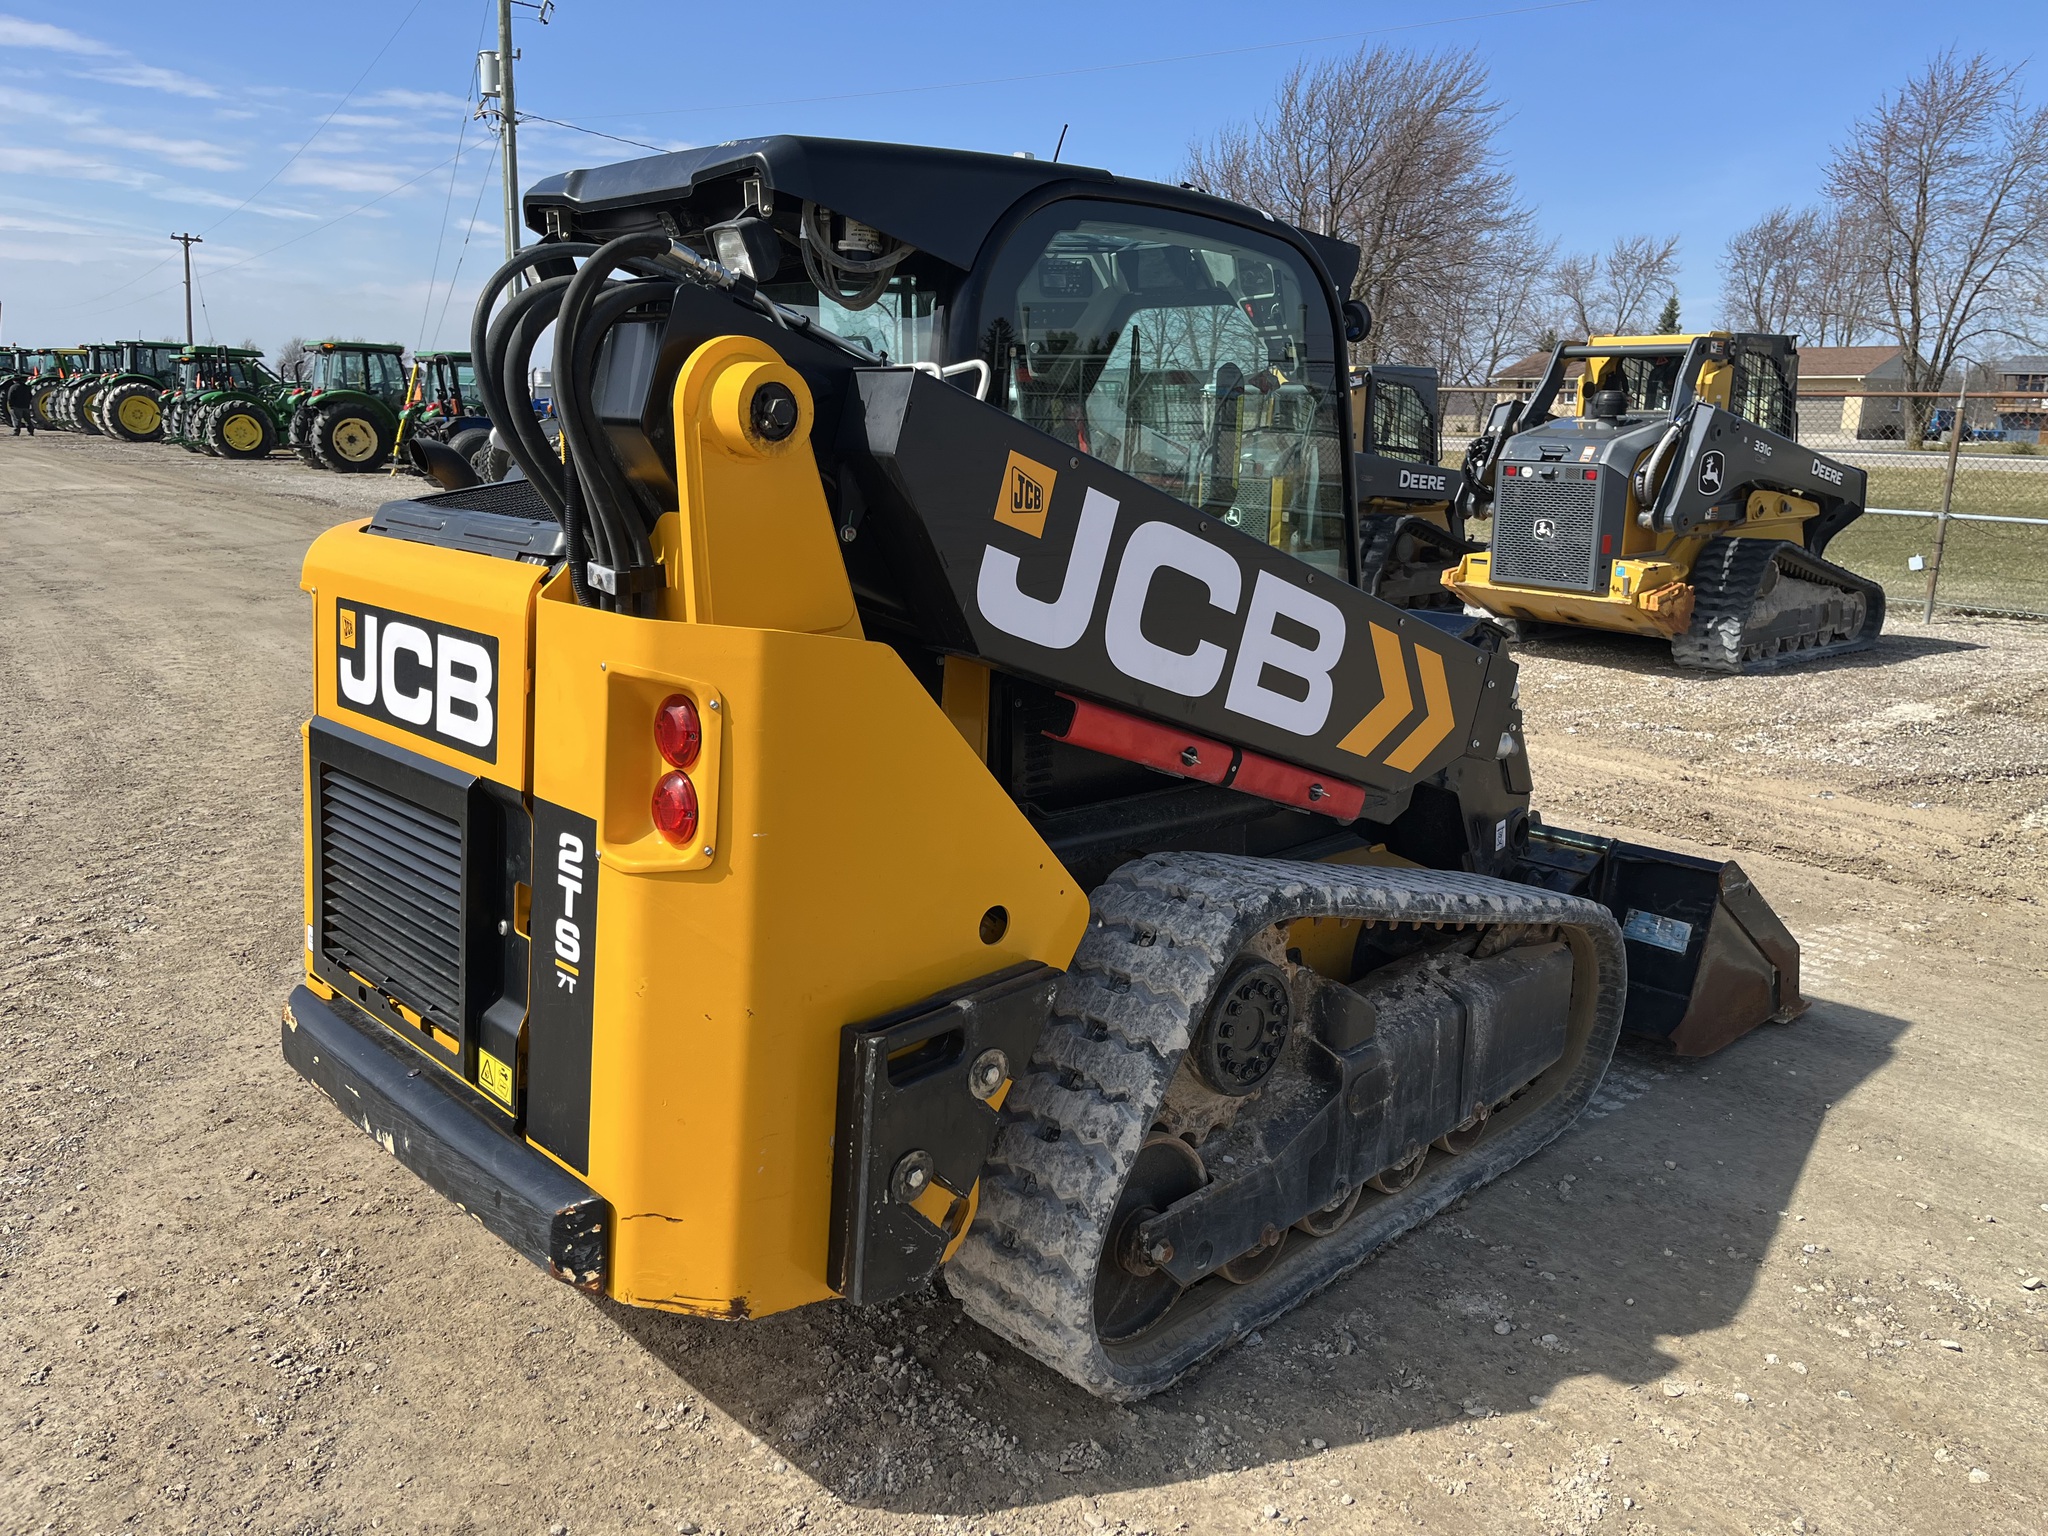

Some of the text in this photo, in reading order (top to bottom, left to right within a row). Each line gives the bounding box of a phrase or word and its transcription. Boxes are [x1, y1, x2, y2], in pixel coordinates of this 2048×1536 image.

[1754, 440, 1772, 456] 331G
[1399, 469, 1446, 491] DEERE
[1811, 458, 1844, 486] DEERE
[1014, 473, 1041, 510] JCB
[977, 486, 1346, 736] JCB
[339, 614, 494, 747] JCB
[556, 971, 577, 994] 7T
